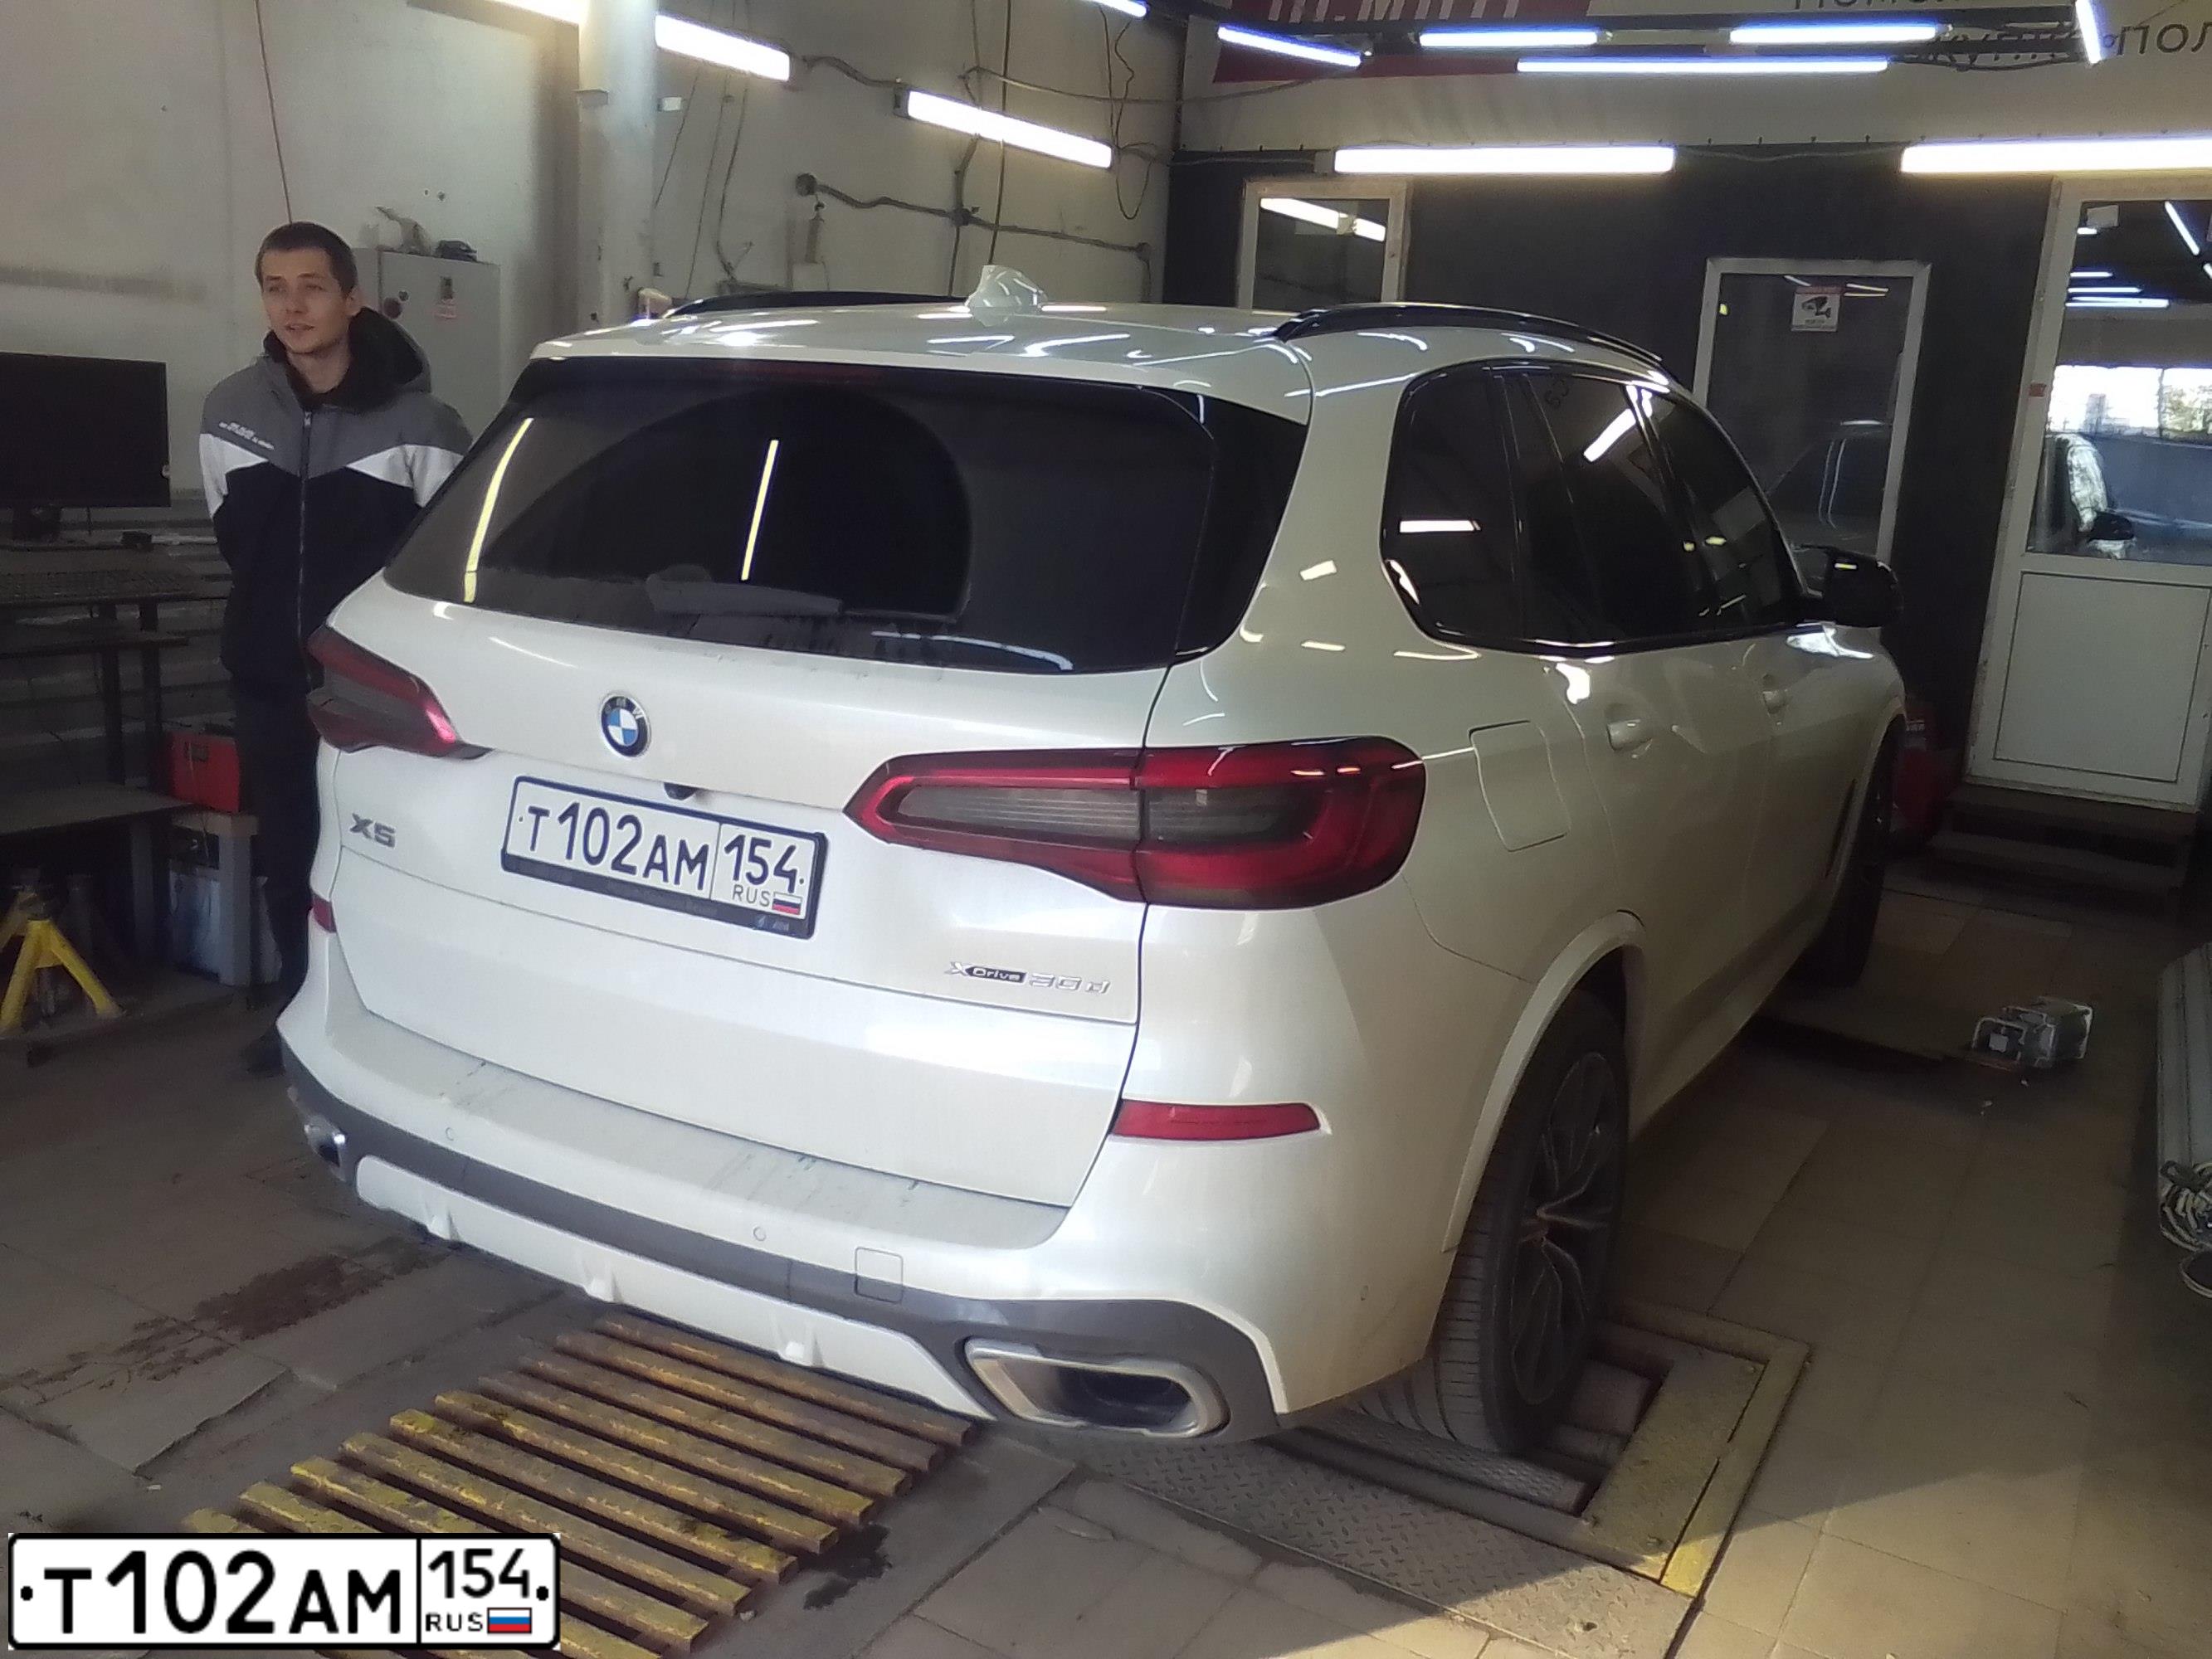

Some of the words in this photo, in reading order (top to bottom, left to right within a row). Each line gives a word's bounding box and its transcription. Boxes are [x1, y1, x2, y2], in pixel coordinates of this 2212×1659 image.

[349, 813, 396, 848] X5
[724, 834, 798, 893] 154
[732, 884, 771, 907] RUS
